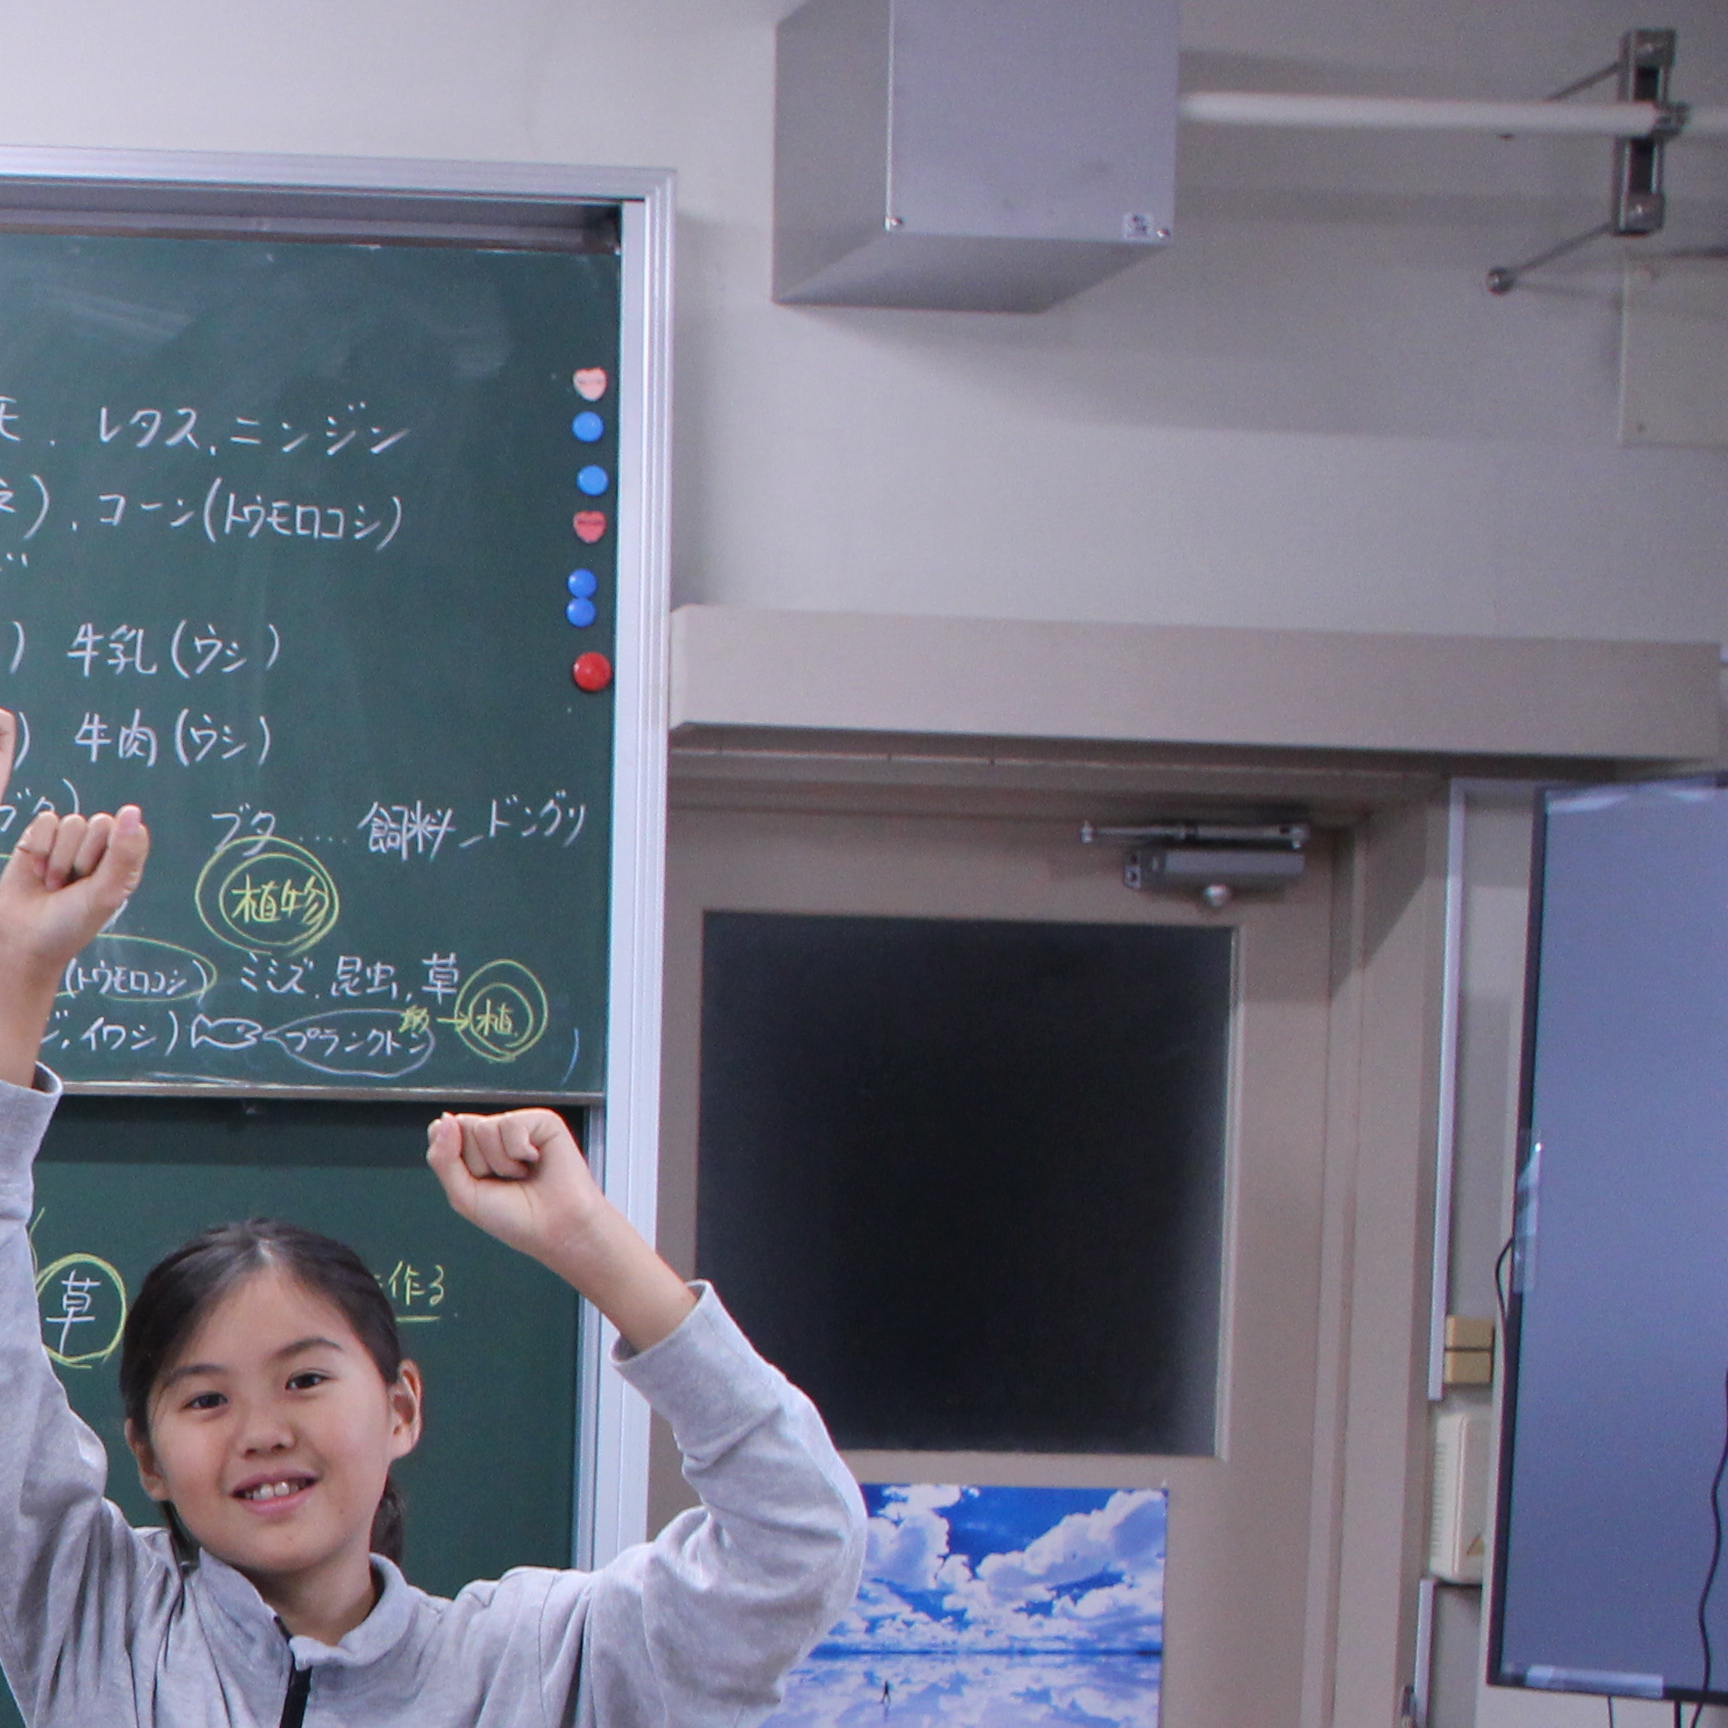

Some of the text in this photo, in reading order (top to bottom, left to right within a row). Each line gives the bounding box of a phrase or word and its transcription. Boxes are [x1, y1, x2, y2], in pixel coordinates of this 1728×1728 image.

[210, 801, 277, 857] ブタ
[231, 874, 329, 925] 植物
[45, 1269, 101, 1356] 草
